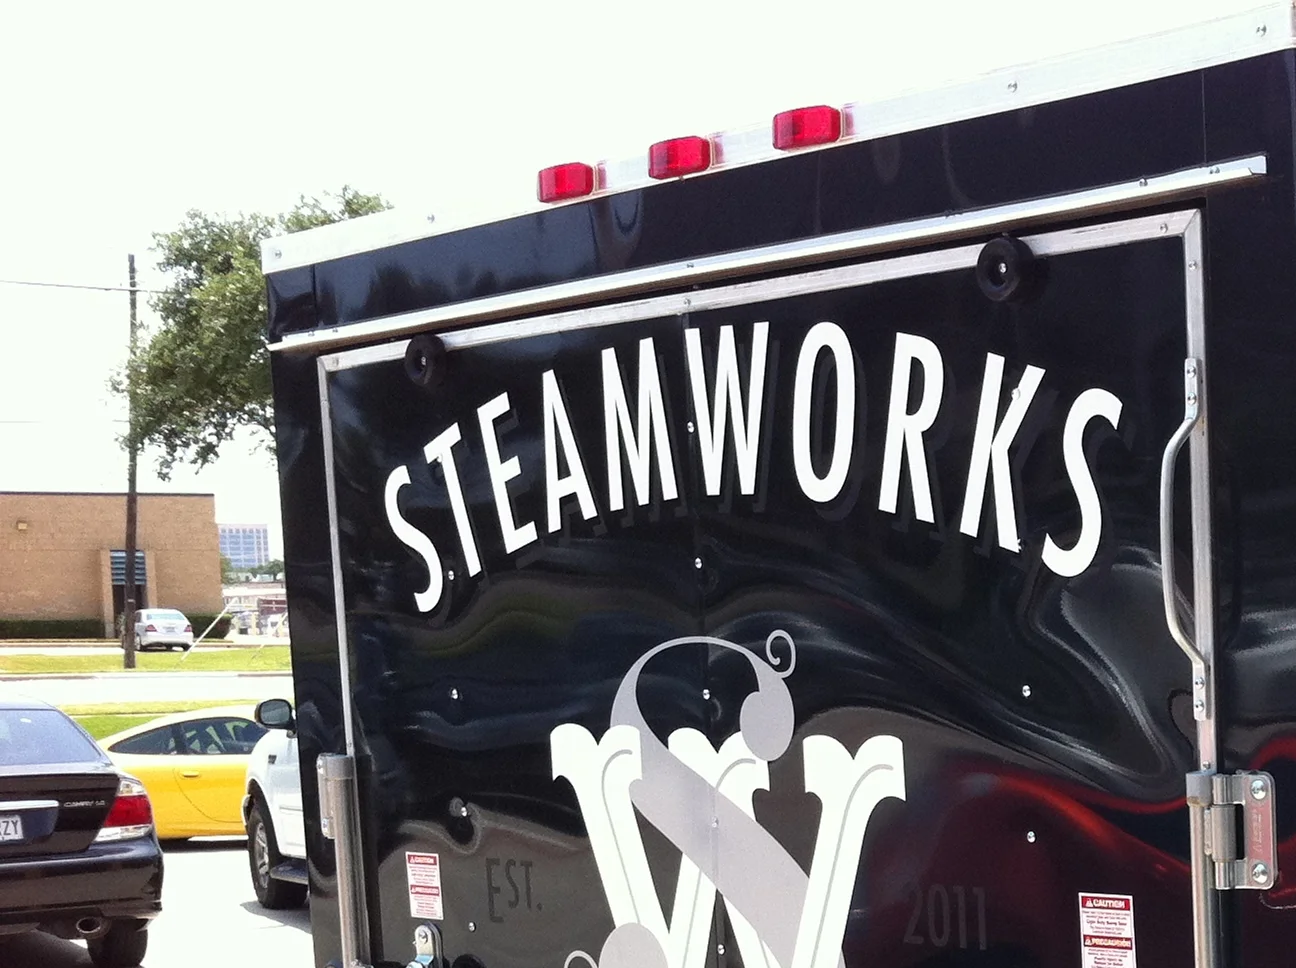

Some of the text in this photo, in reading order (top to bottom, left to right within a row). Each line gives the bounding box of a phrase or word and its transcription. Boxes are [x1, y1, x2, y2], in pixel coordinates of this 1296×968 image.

[384, 321, 1123, 613] STEAMWORKS
[0, 820, 18, 836] ZY
[486, 857, 543, 923] EST.
[904, 882, 988, 951] 2011
[1092, 898, 1126, 909] CAUTION
